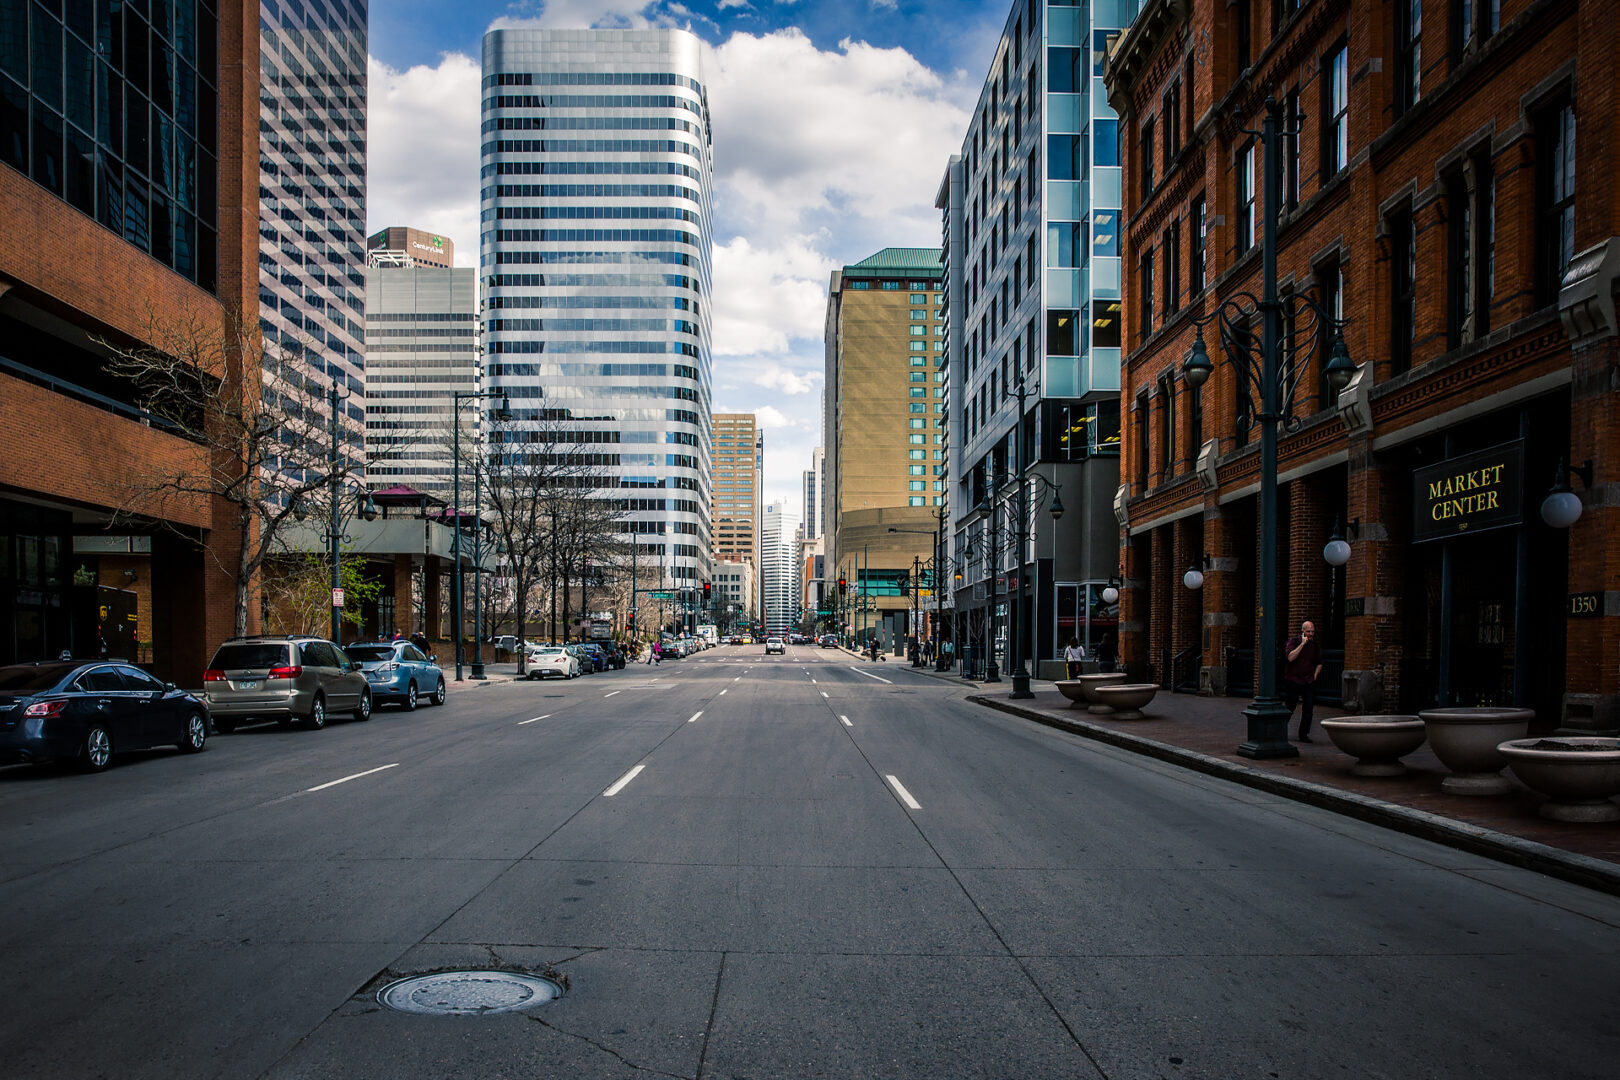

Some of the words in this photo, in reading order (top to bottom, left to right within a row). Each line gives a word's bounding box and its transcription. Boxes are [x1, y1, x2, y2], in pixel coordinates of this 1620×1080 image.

[1429, 464, 1505, 500] MARKET
[1432, 491, 1500, 521] CENTER
[1571, 596, 1597, 614] 1350
